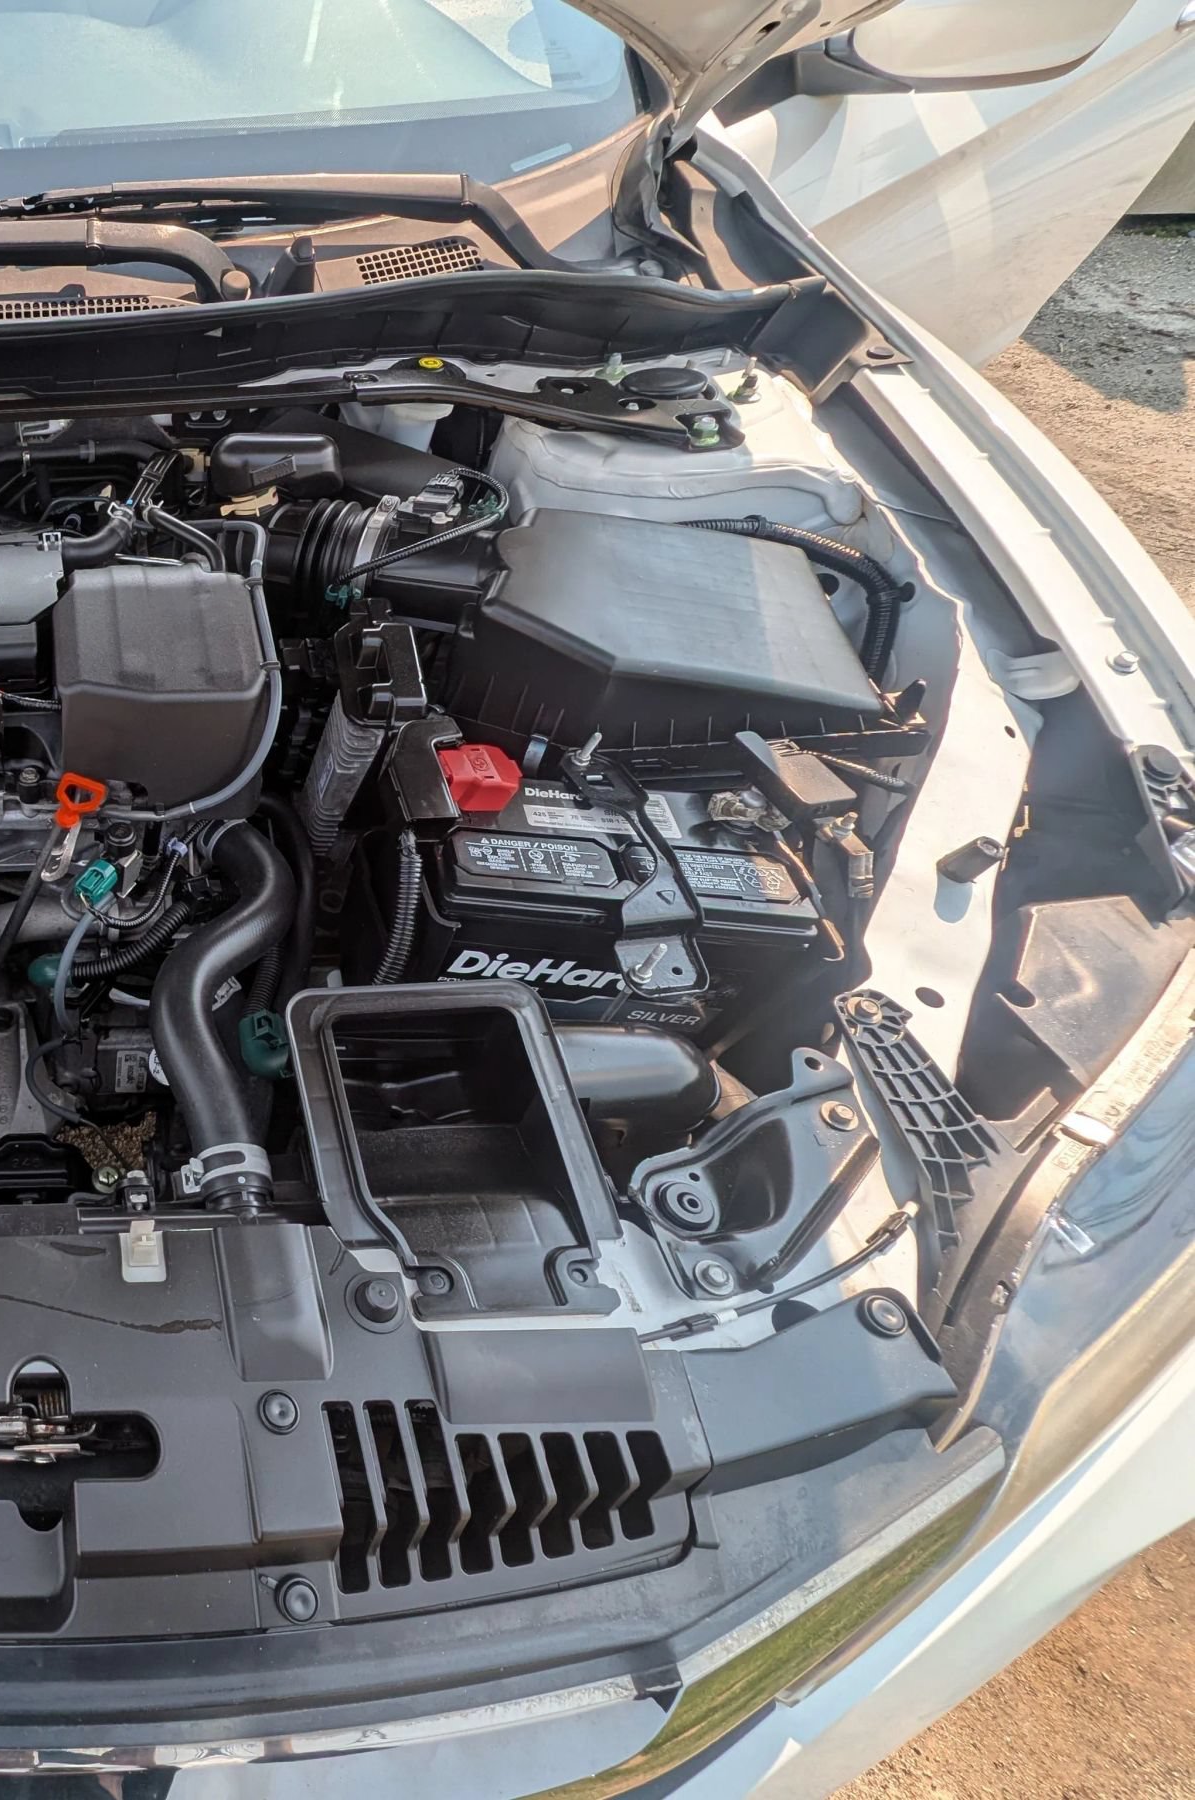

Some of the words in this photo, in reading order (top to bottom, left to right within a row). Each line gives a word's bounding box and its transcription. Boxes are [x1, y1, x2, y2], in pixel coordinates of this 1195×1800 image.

[490, 838, 531, 848] DANGER
[541, 842, 578, 851] POISON
[627, 1010, 702, 1026] SILVER
